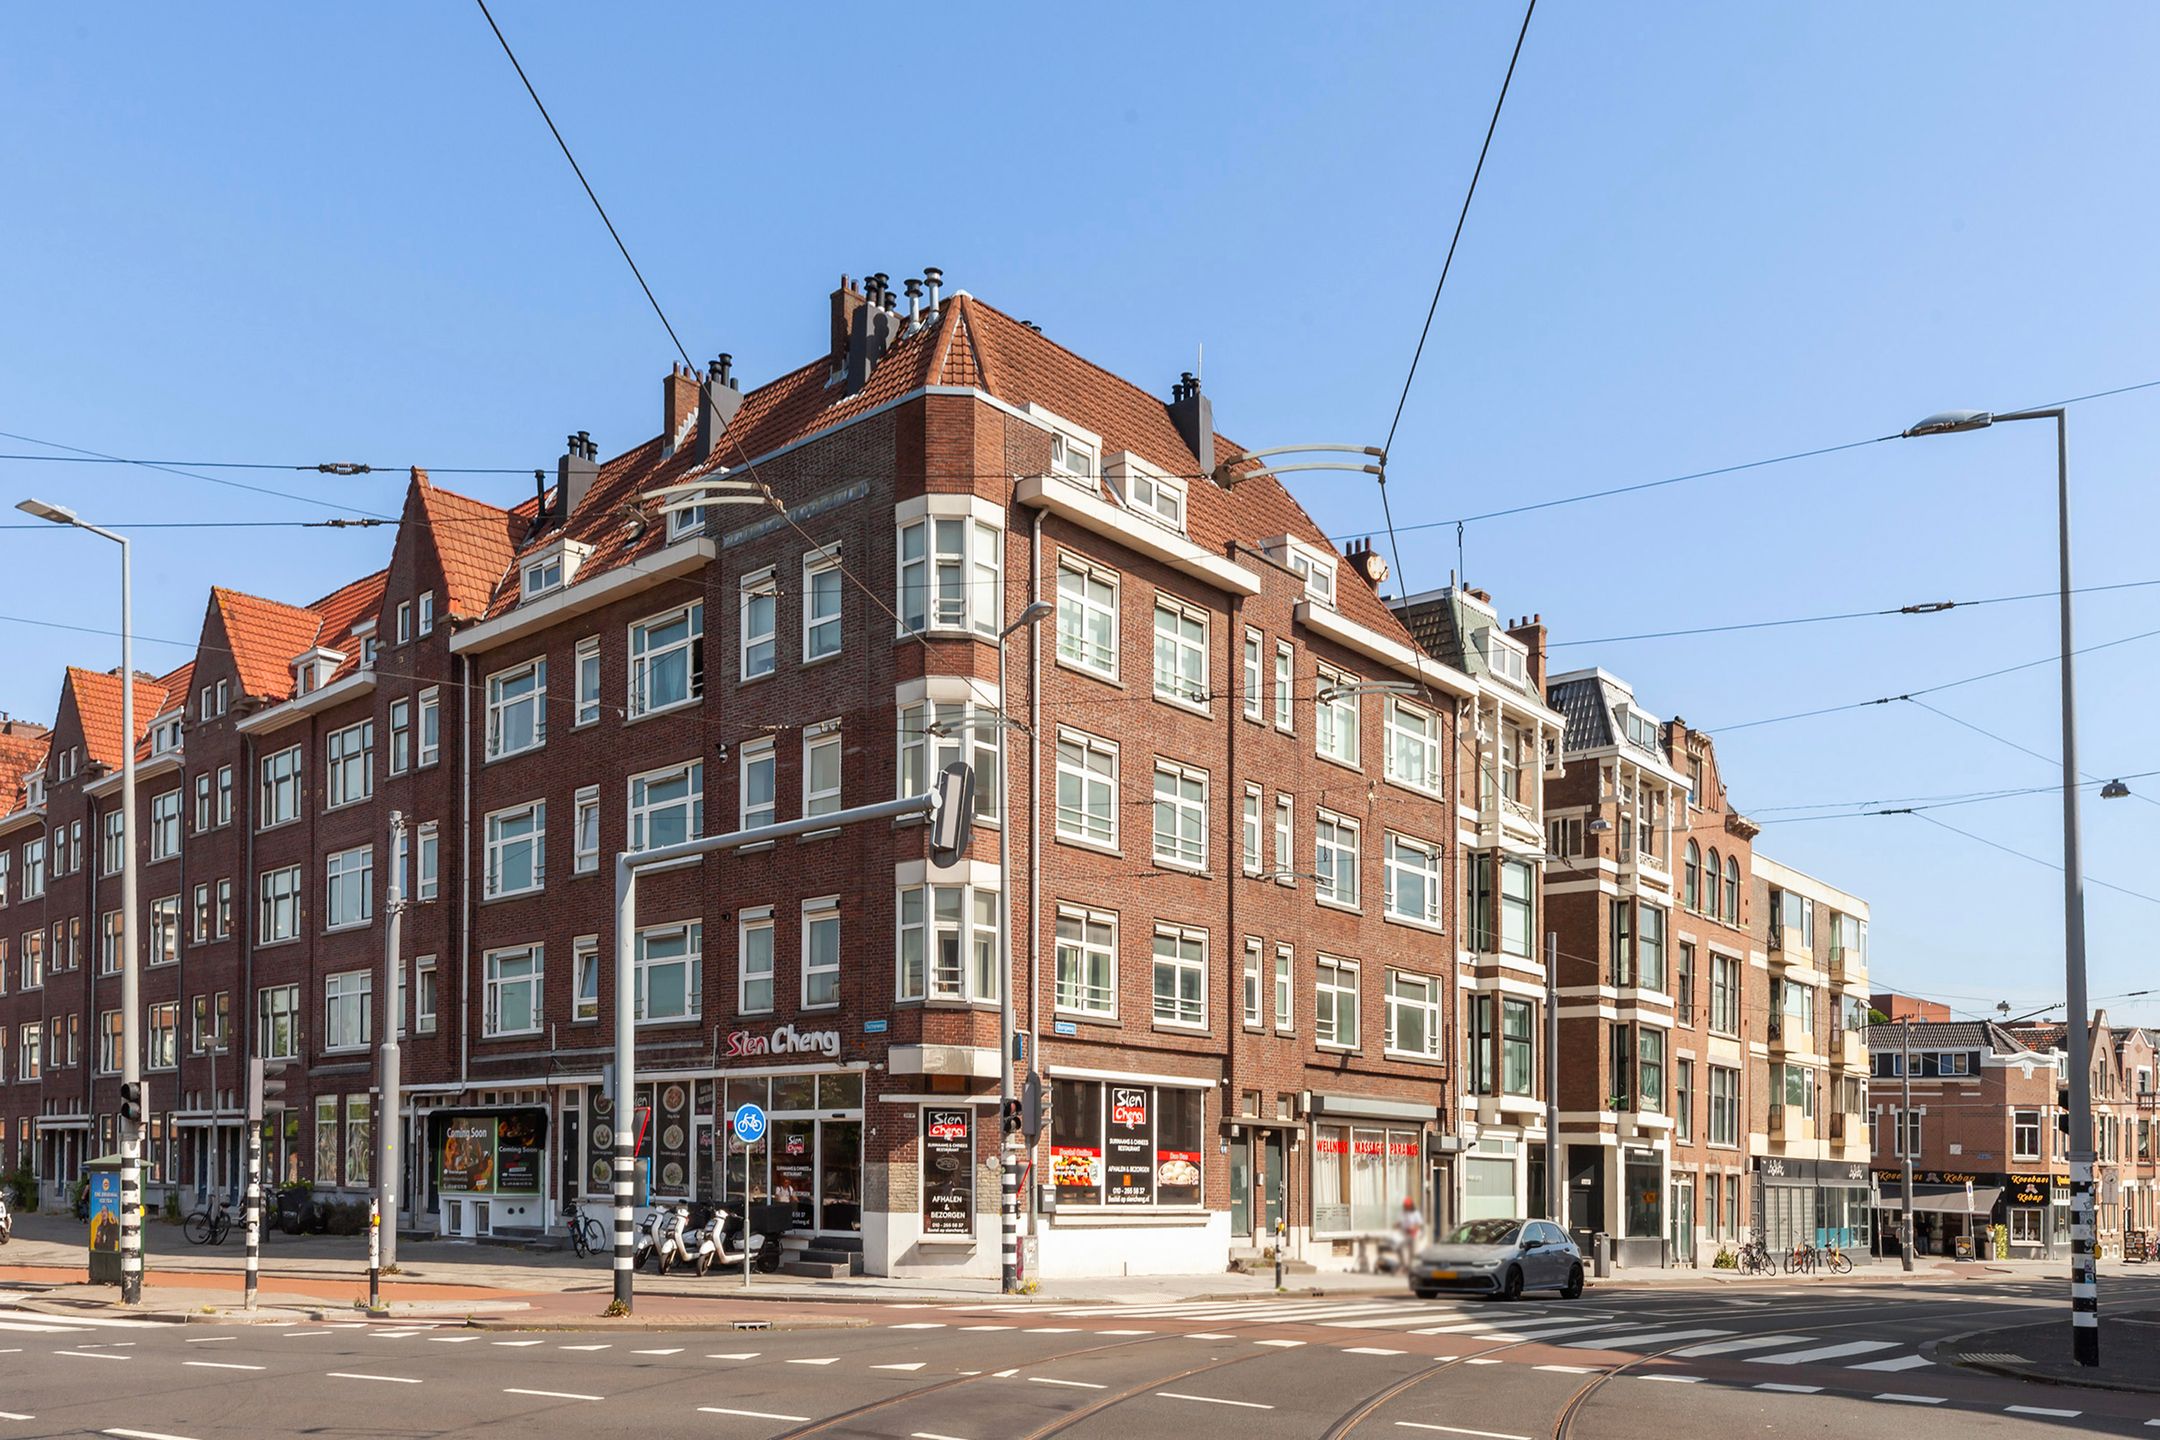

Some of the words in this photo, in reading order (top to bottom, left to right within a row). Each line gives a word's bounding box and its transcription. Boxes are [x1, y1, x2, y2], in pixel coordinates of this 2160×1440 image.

[727, 1031, 769, 1056] Sien
[771, 1024, 840, 1057] Cheng
[634, 1096, 648, 1106] ien
[1117, 1090, 1142, 1107] Sien
[933, 1112, 963, 1125] Sien
[447, 1127, 470, 1140] Coming
[471, 1127, 487, 1138] Soon
[499, 1146, 522, 1154] Coming
[1354, 1141, 1385, 1156] MASSAGE
[932, 1195, 962, 1203] AFHALEN
[2017, 1193, 2044, 1203] Kebap
